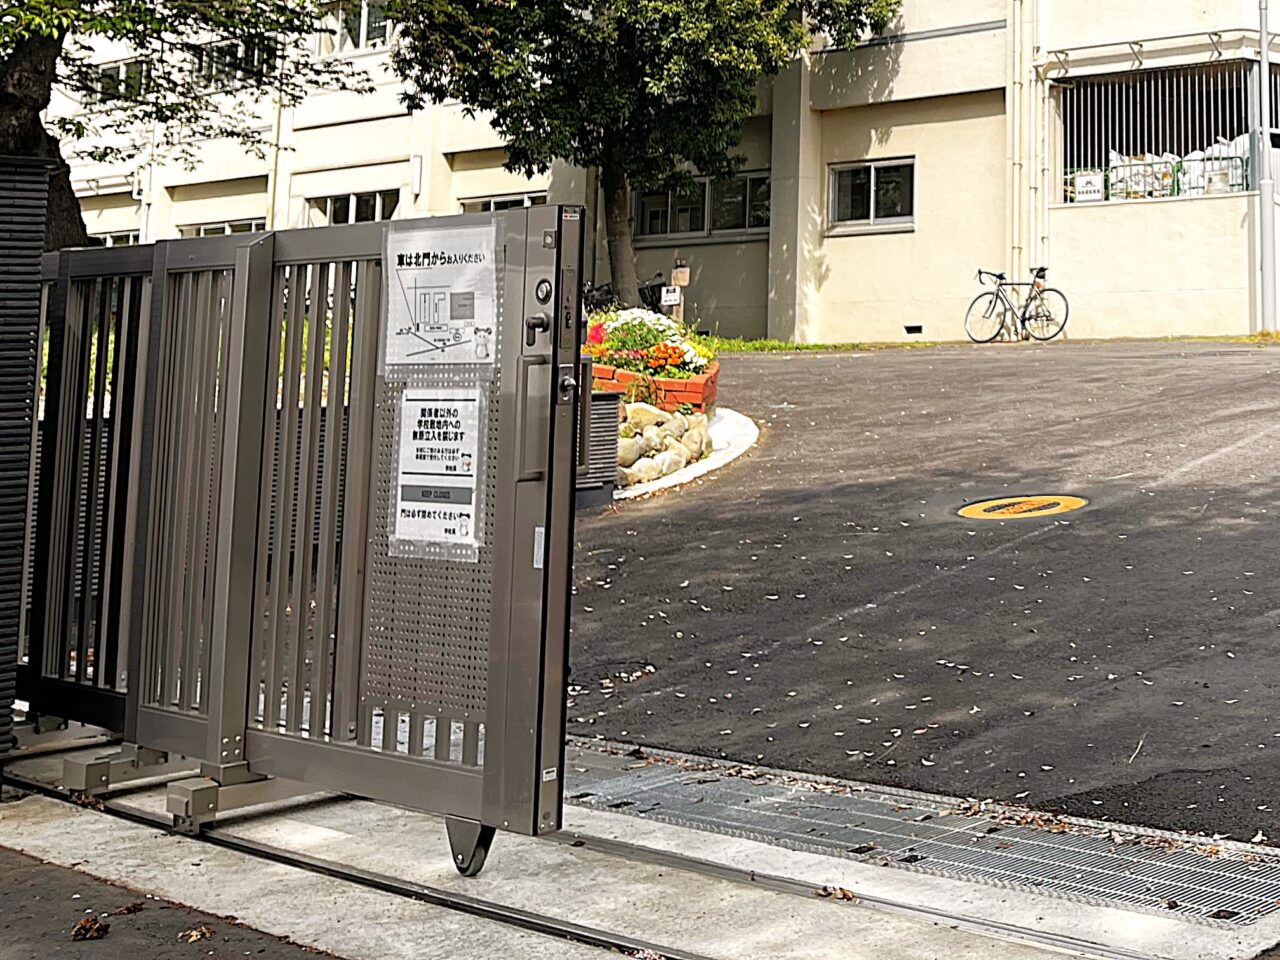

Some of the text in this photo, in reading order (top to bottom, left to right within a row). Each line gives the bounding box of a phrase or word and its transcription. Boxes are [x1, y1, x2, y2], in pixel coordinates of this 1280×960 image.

[397, 251, 485, 267] 車は北門からお入りください
